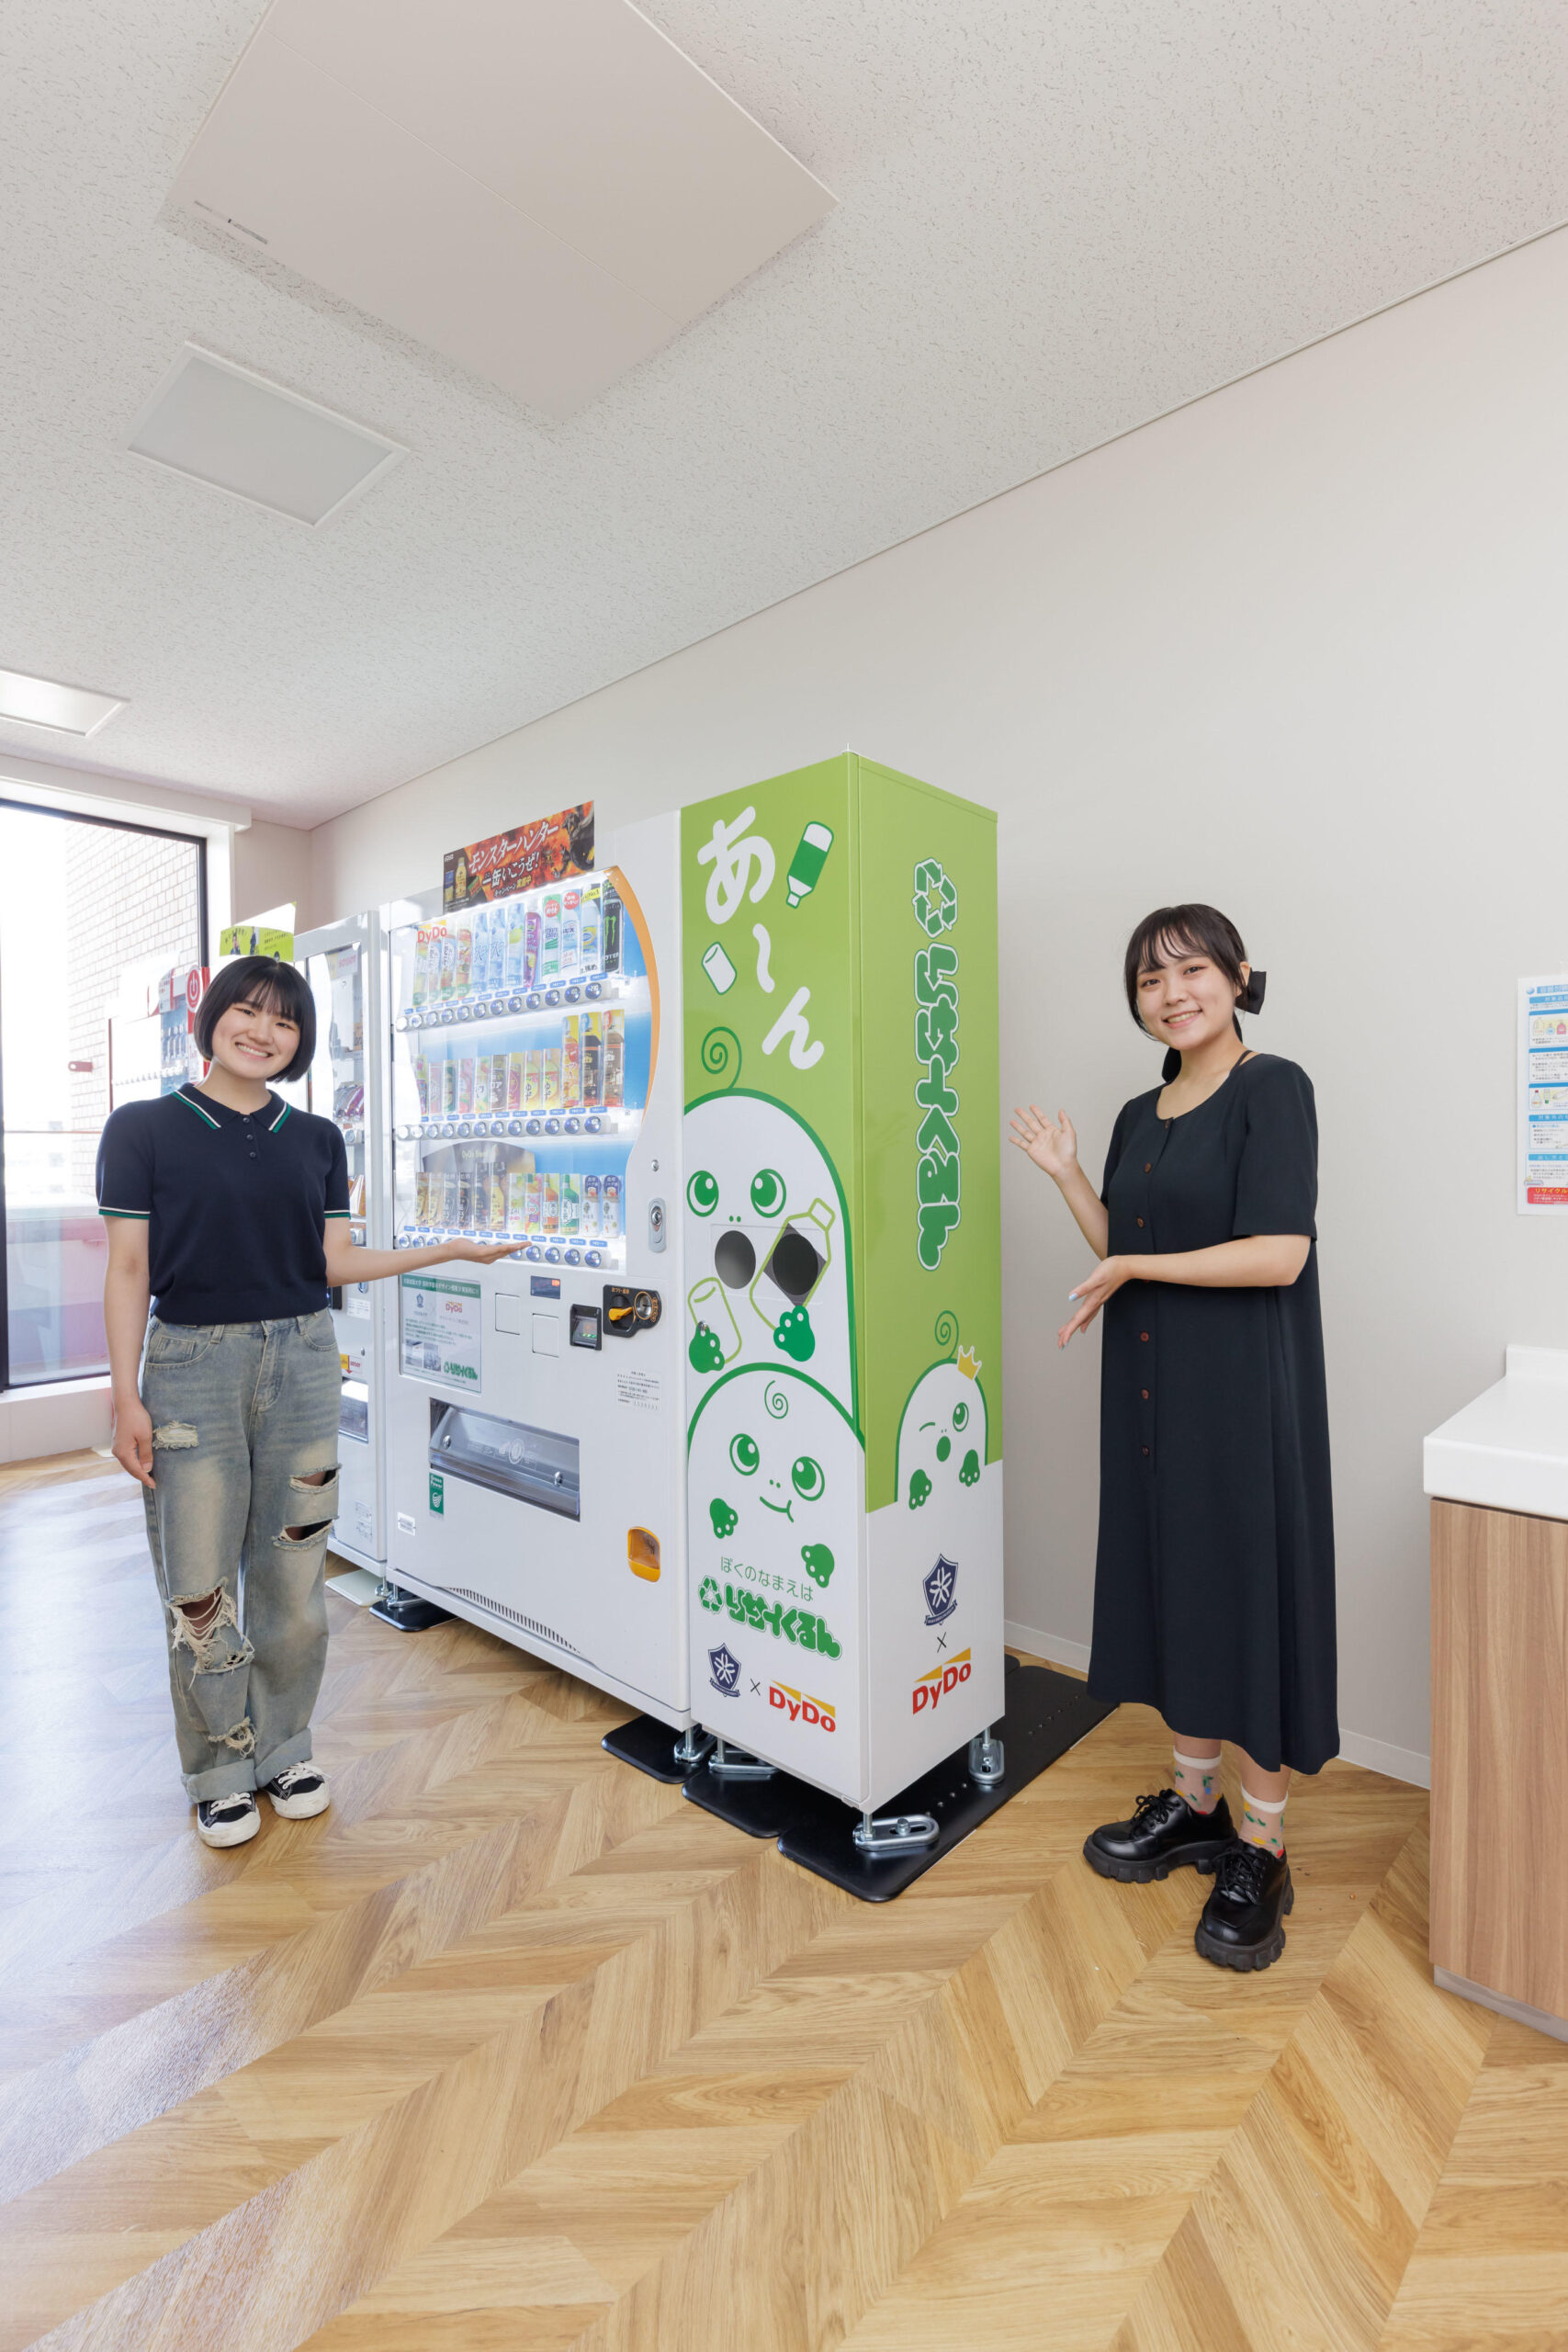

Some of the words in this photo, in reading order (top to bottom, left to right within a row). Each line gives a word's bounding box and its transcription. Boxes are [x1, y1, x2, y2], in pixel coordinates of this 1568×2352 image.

[469, 821, 558, 873] モンスターハンター
[417, 927, 447, 944] DyDo
[446, 1303, 463, 1313] DyDo
[721, 1555, 813, 1601] ぼくのなまえは
[769, 1686, 836, 1732] DyDo
[912, 1663, 971, 1714] DyDo
